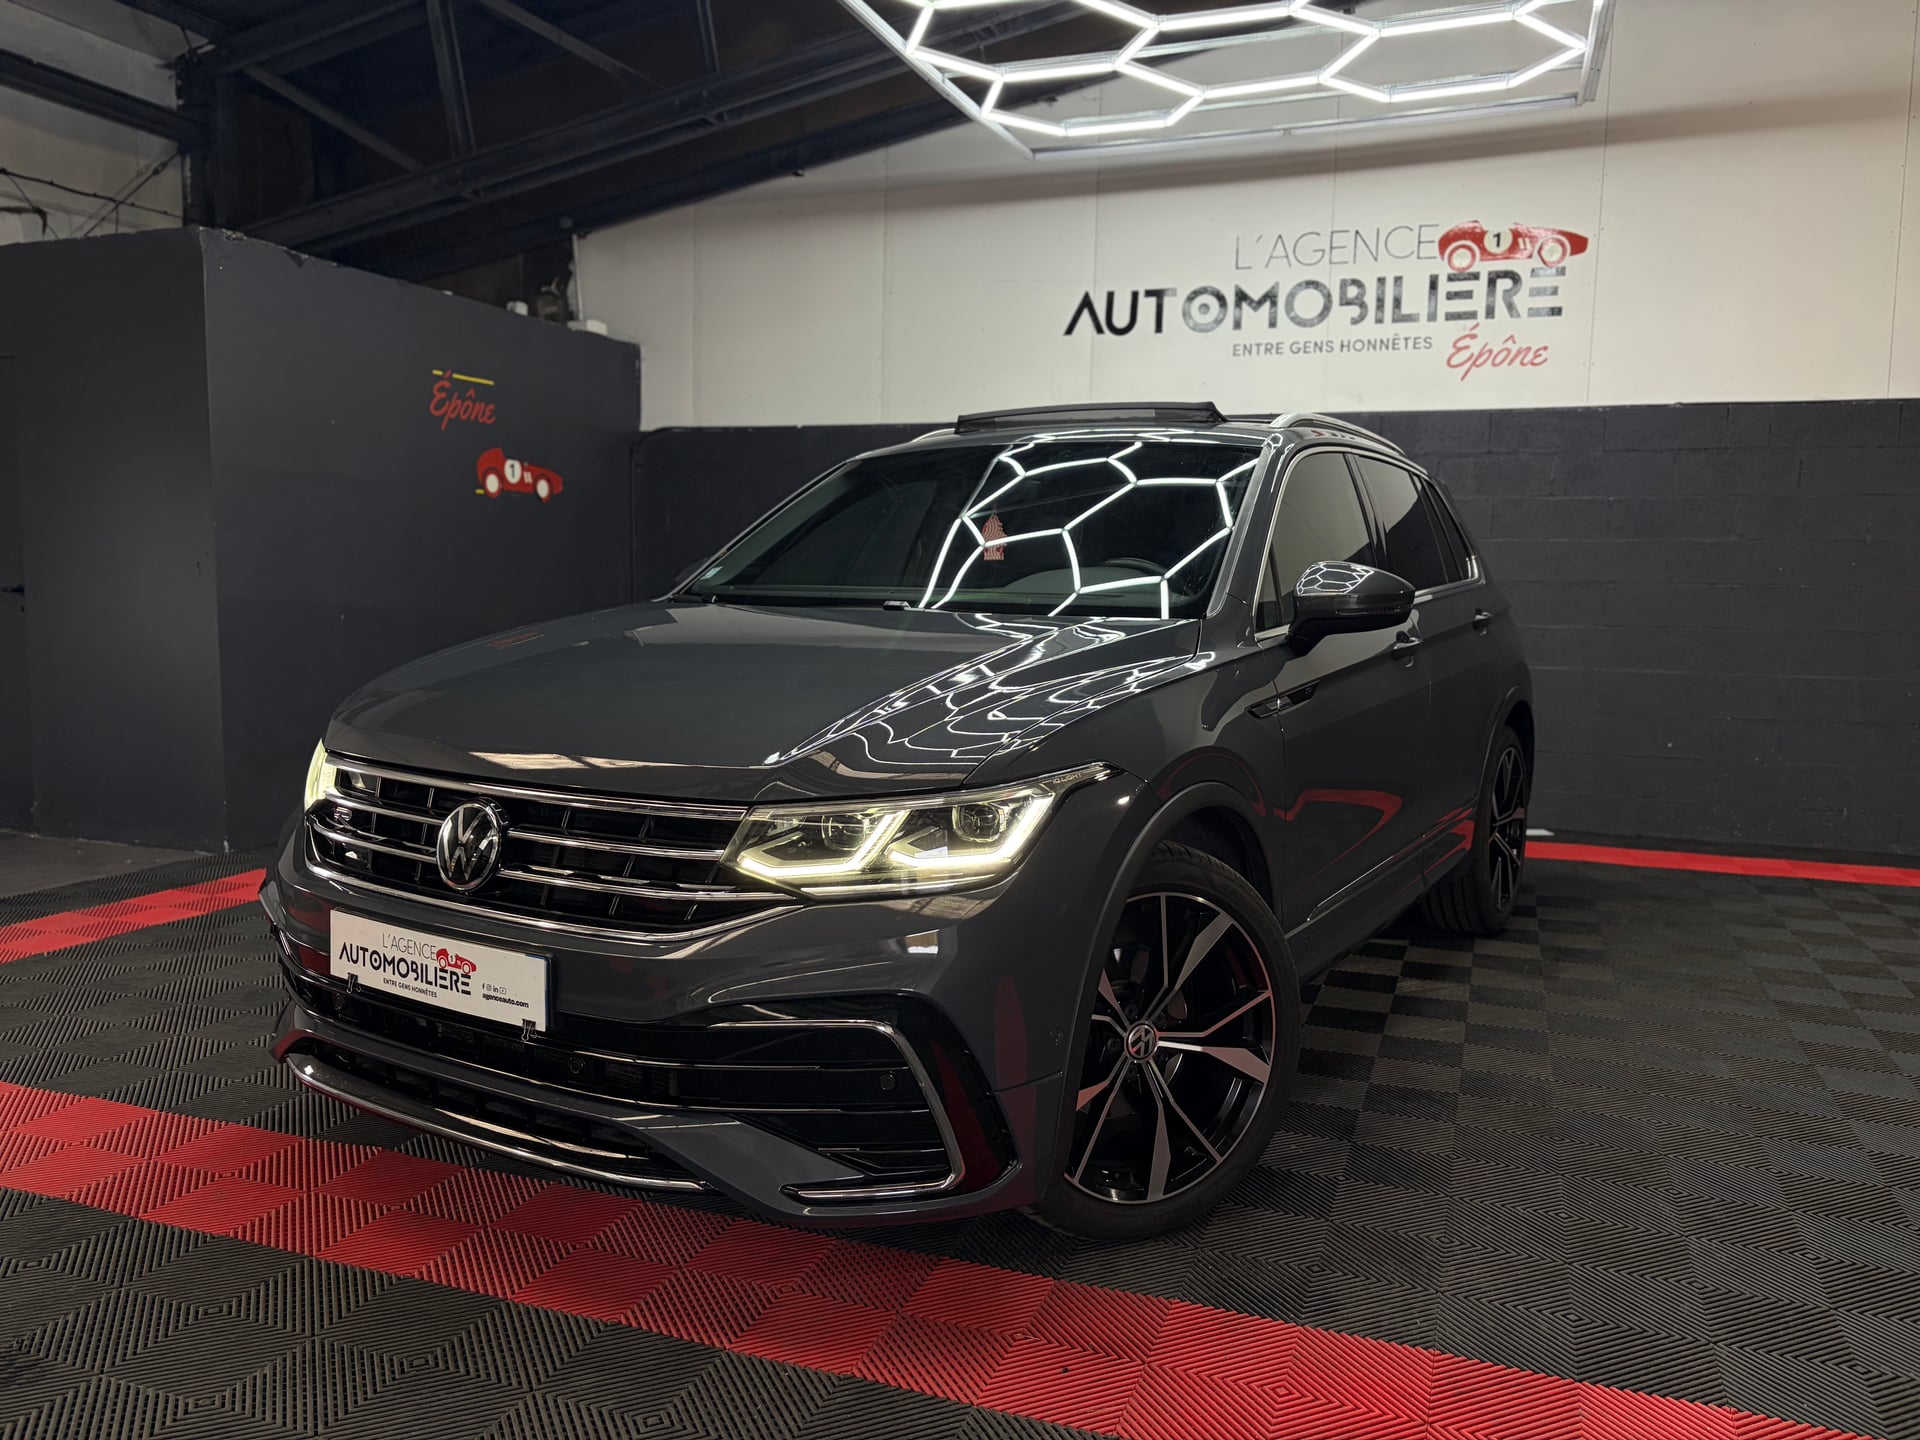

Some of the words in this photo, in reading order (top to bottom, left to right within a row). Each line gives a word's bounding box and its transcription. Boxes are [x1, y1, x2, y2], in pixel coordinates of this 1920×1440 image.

[1234, 223, 1439, 271] L'AGENCE
[1493, 231, 1502, 248] 1
[1232, 341, 1286, 358] ENTRE
[1289, 339, 1335, 356] GENS
[1339, 333, 1433, 353] HONNÊTES
[1446, 322, 1549, 382] Épône
[429, 369, 496, 431] Épône
[509, 463, 516, 479] 1
[382, 932, 437, 961] L'AGENCE
[383, 977, 397, 987] ENTRE
[398, 981, 411, 991] GENS
[412, 986, 438, 998] HONNÊTES
[482, 993, 530, 1008] agenceauto.com
